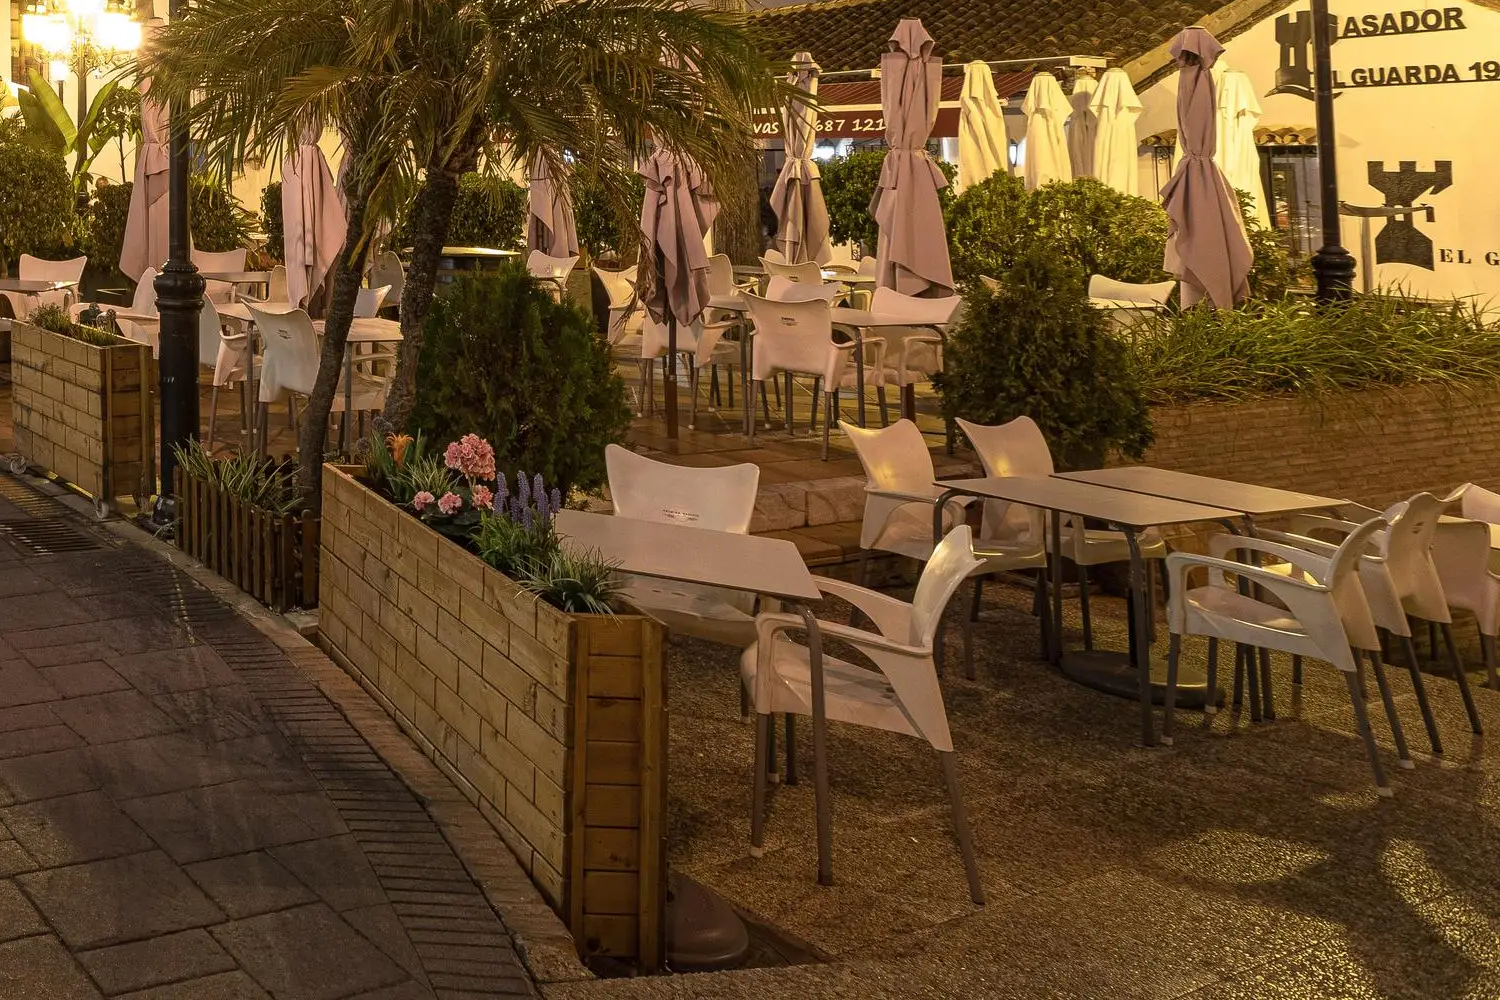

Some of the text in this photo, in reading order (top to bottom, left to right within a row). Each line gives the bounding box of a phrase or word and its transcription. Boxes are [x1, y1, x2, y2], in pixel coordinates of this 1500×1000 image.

[1343, 7, 1467, 38] ASADOR
[1351, 63, 1461, 86] GUARDA
[753, 122, 780, 134] vas
[1439, 248, 1500, 266] EL G
